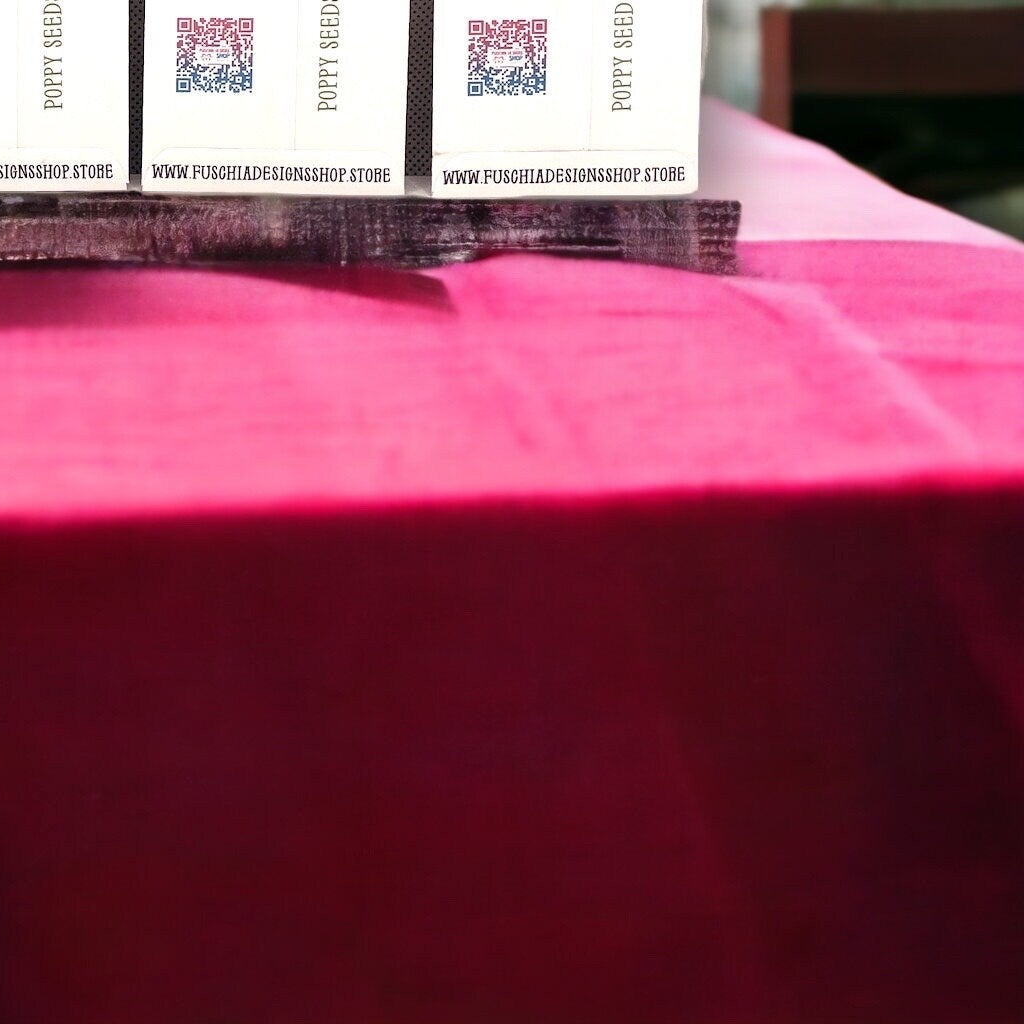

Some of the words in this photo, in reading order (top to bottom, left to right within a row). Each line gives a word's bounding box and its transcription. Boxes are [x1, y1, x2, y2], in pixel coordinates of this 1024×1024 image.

[43, 54, 64, 111] POPPY
[316, 56, 339, 113] POPPY
[611, 55, 633, 113] POPPY
[151, 163, 391, 184] WWW.FUSCHIADESIGNSSHOP.STORE
[441, 165, 686, 186] WWW.FUSCHIADESIGNSSHOP.STORE
